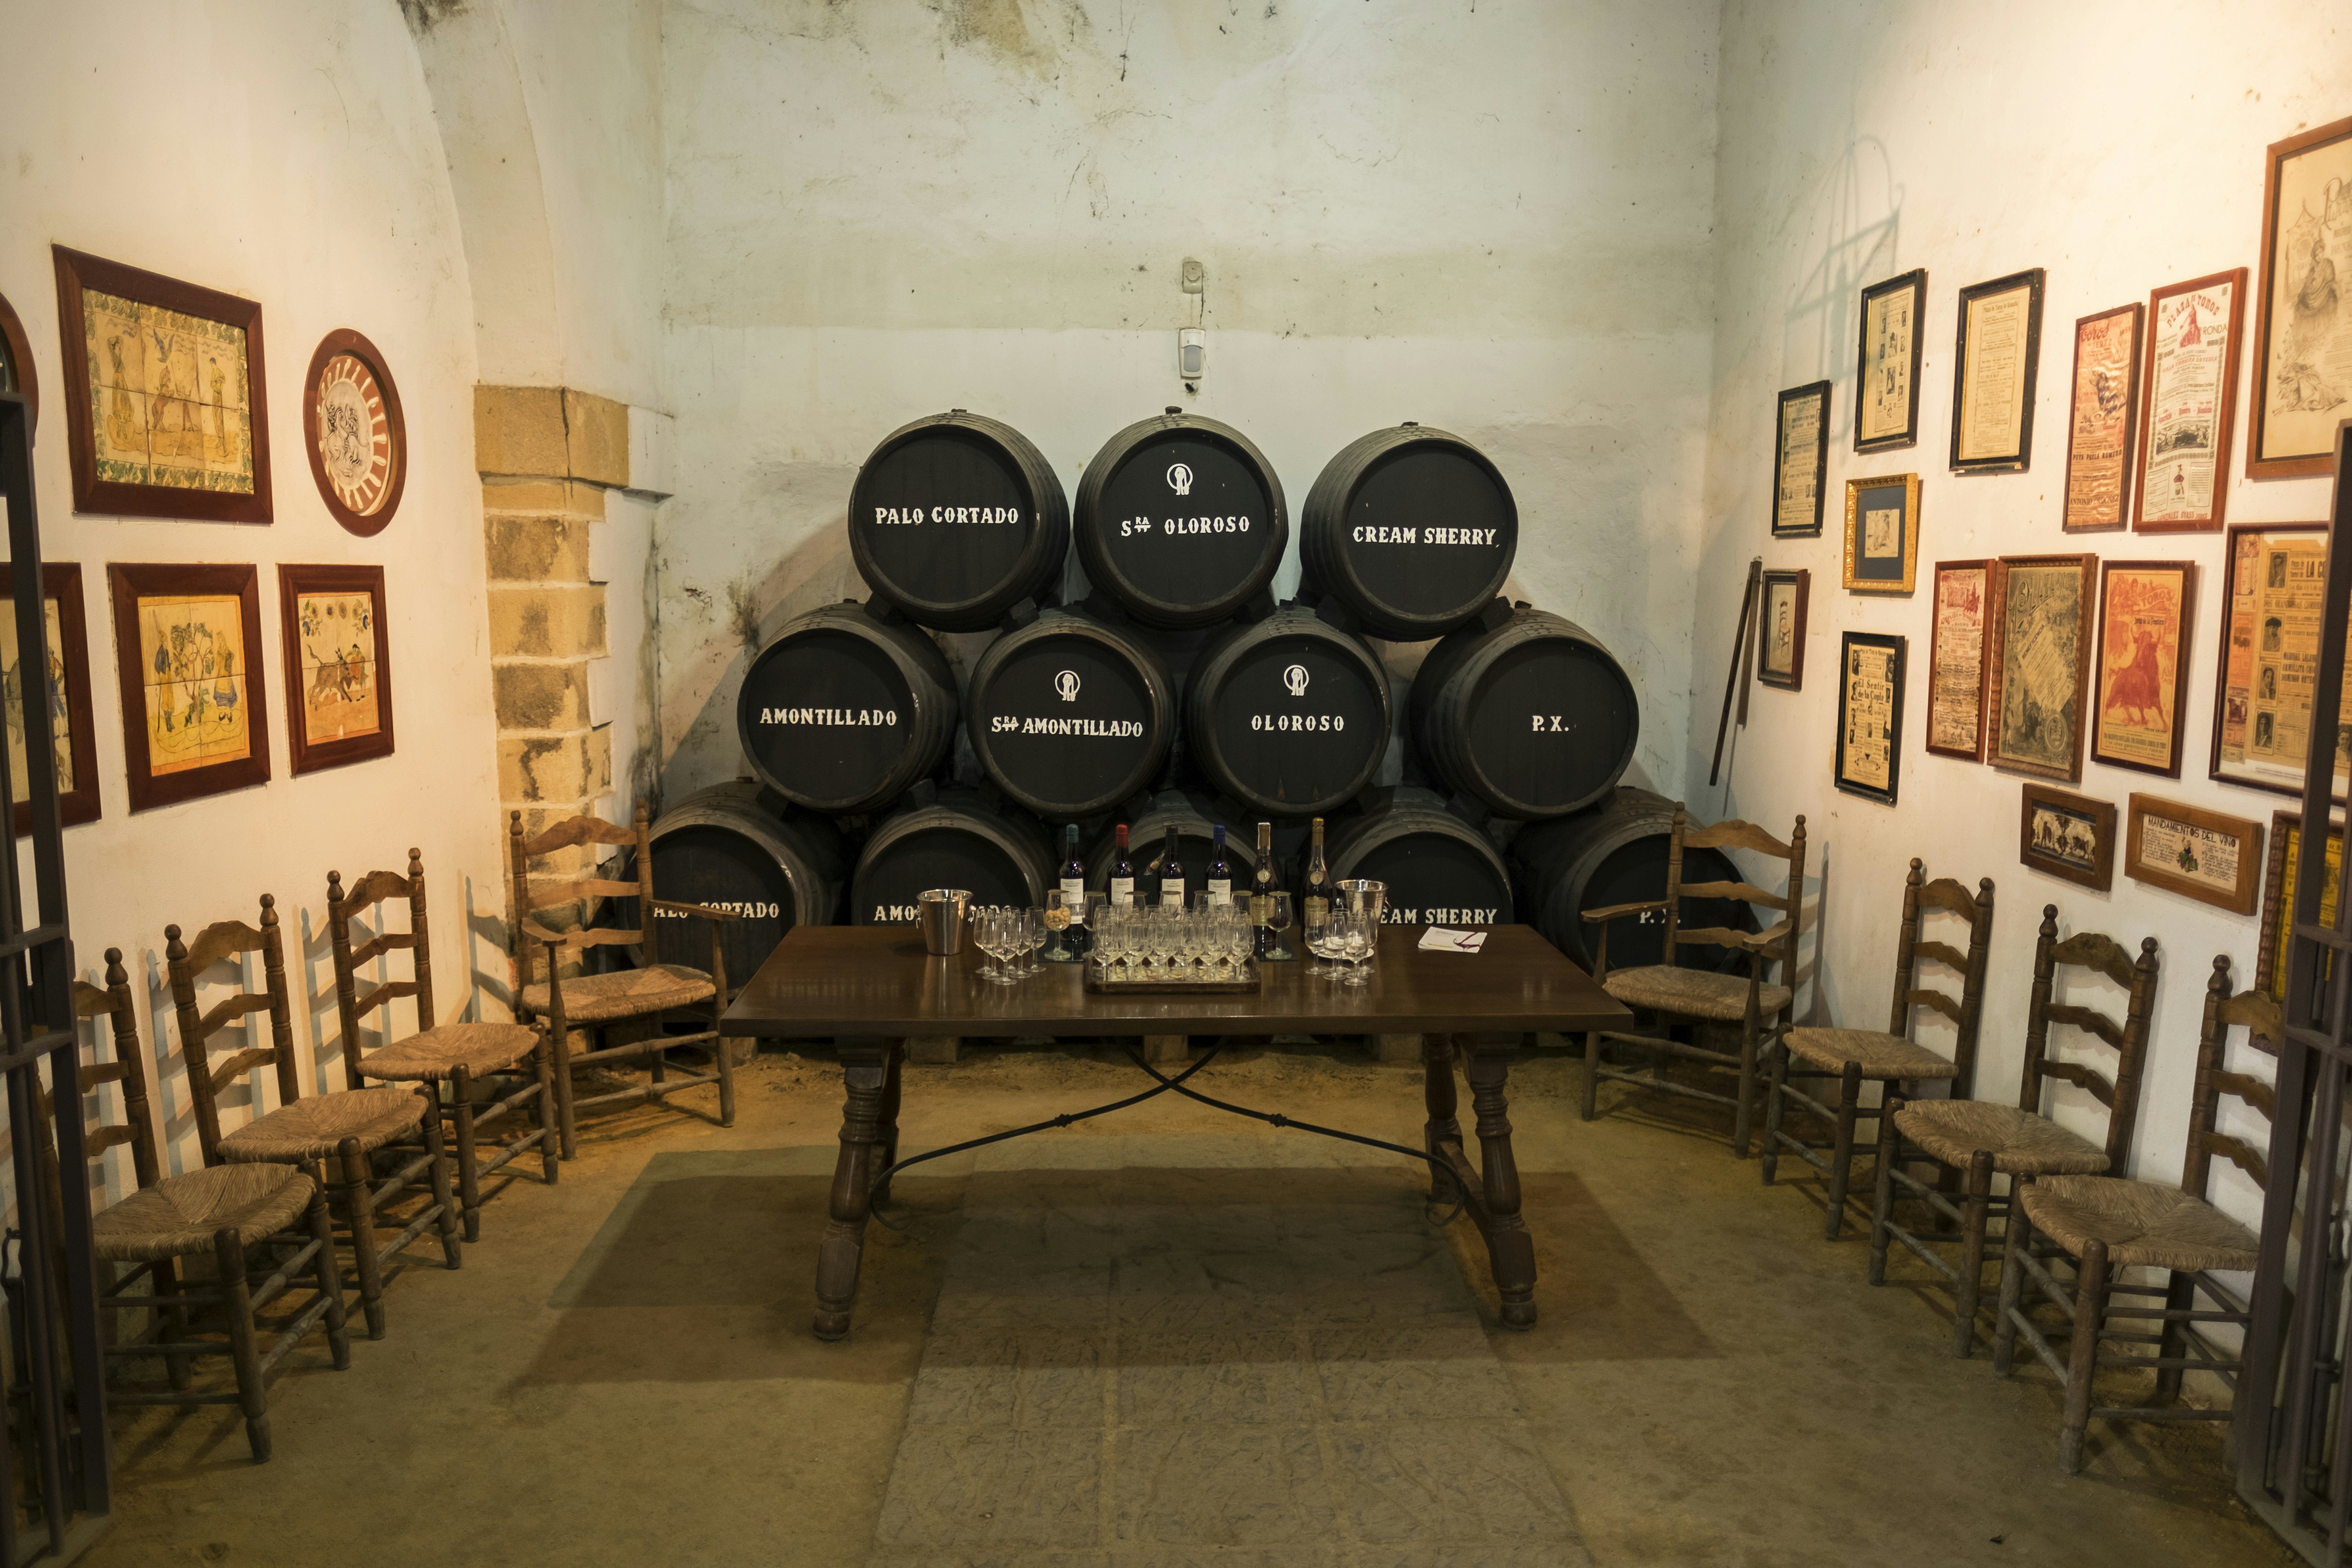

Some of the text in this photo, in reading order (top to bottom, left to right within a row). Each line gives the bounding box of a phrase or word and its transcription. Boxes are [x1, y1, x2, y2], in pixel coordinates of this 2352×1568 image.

[2167, 298, 2190, 328] PLAZA
[2197, 294, 2220, 316] TOROS
[2203, 323, 2227, 335] RONDA
[2093, 338, 2112, 350] JEREZ
[2102, 449, 2122, 459] ROMERO
[875, 506, 1019, 524] PALO CORTADO
[1164, 516, 1250, 535] OLOROSO
[1353, 527, 1496, 544] CREAM SHERRY
[2306, 561, 2315, 577] LA
[2142, 590, 2171, 607] TOROS
[2151, 617, 2164, 625] Frontera
[1859, 678, 1884, 691] El Sentir
[1858, 689, 1884, 703] de la Copla
[760, 708, 897, 726] AMONTILLADO
[1251, 715, 1344, 731] OLOROSO
[1021, 718, 1143, 737] AMONTILLADO
[2148, 816, 2236, 848] MANDAMIENTOS DEL VINO
[1425, 908, 1497, 924] SHERRY
